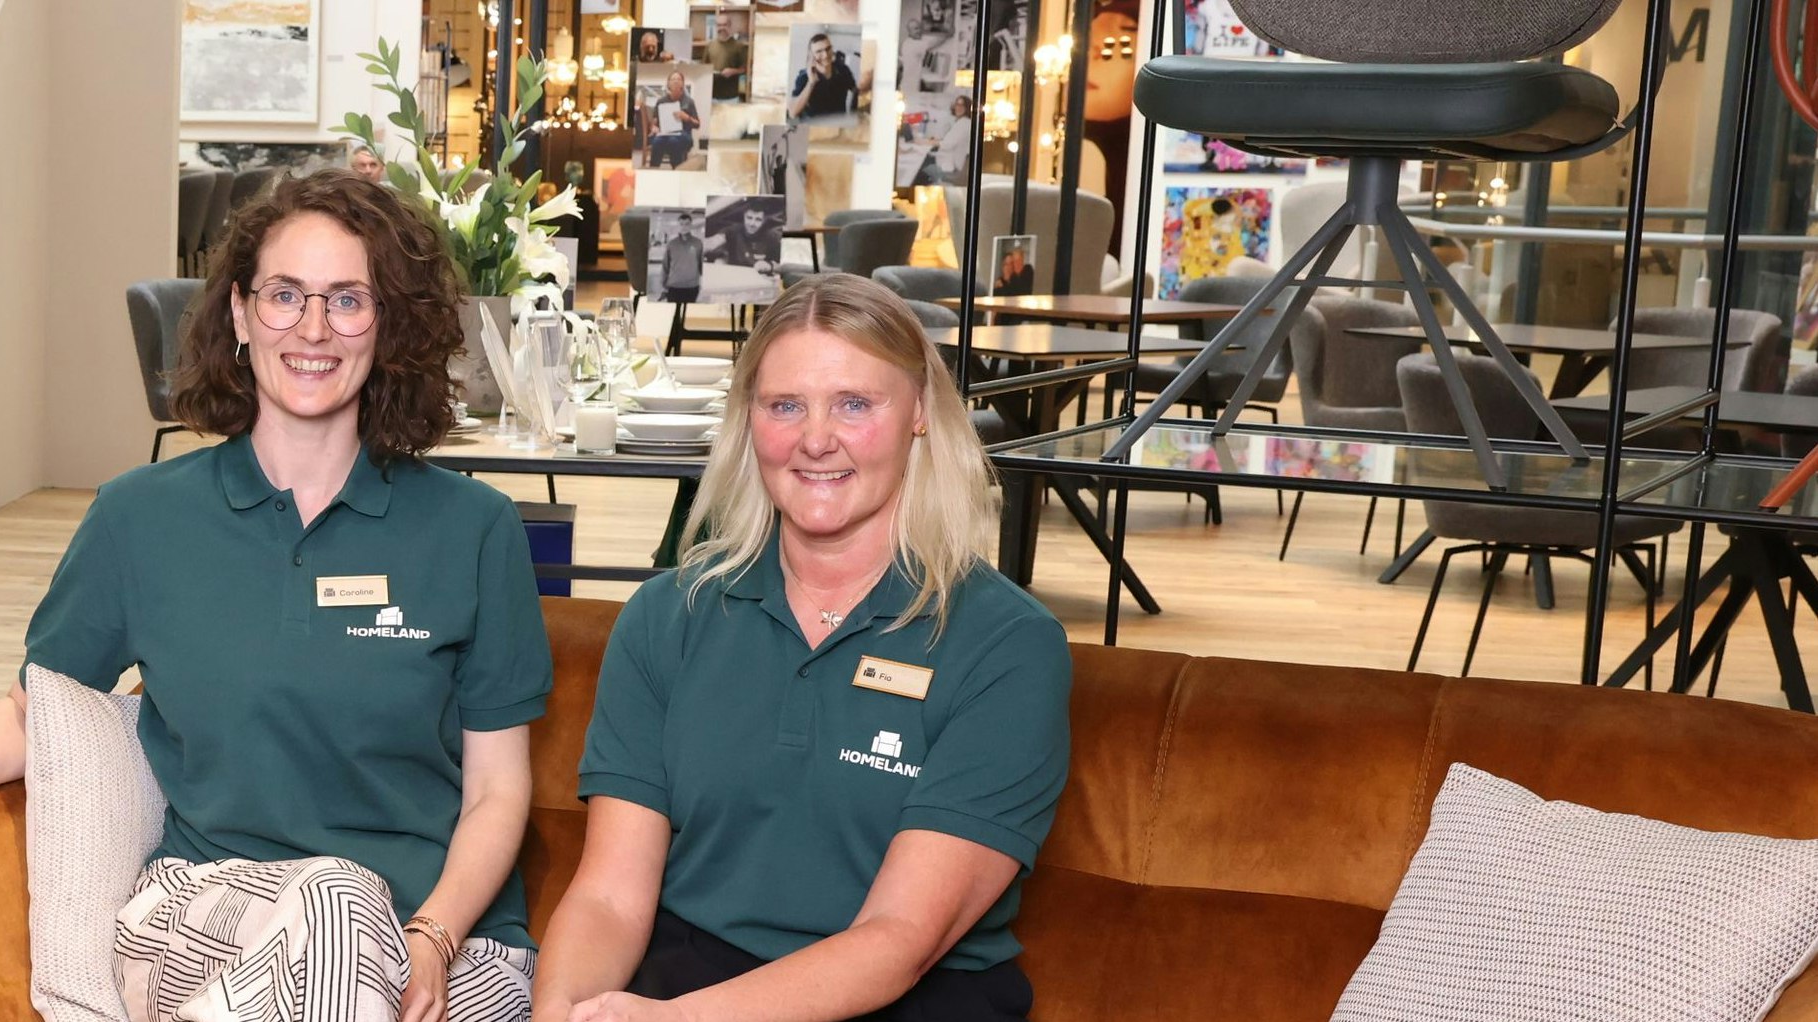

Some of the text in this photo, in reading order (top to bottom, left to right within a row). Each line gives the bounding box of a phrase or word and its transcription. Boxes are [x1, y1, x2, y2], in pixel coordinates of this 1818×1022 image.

[339, 588, 374, 598] Caroline
[346, 626, 431, 639] HOMELAND
[878, 672, 892, 682] Fia
